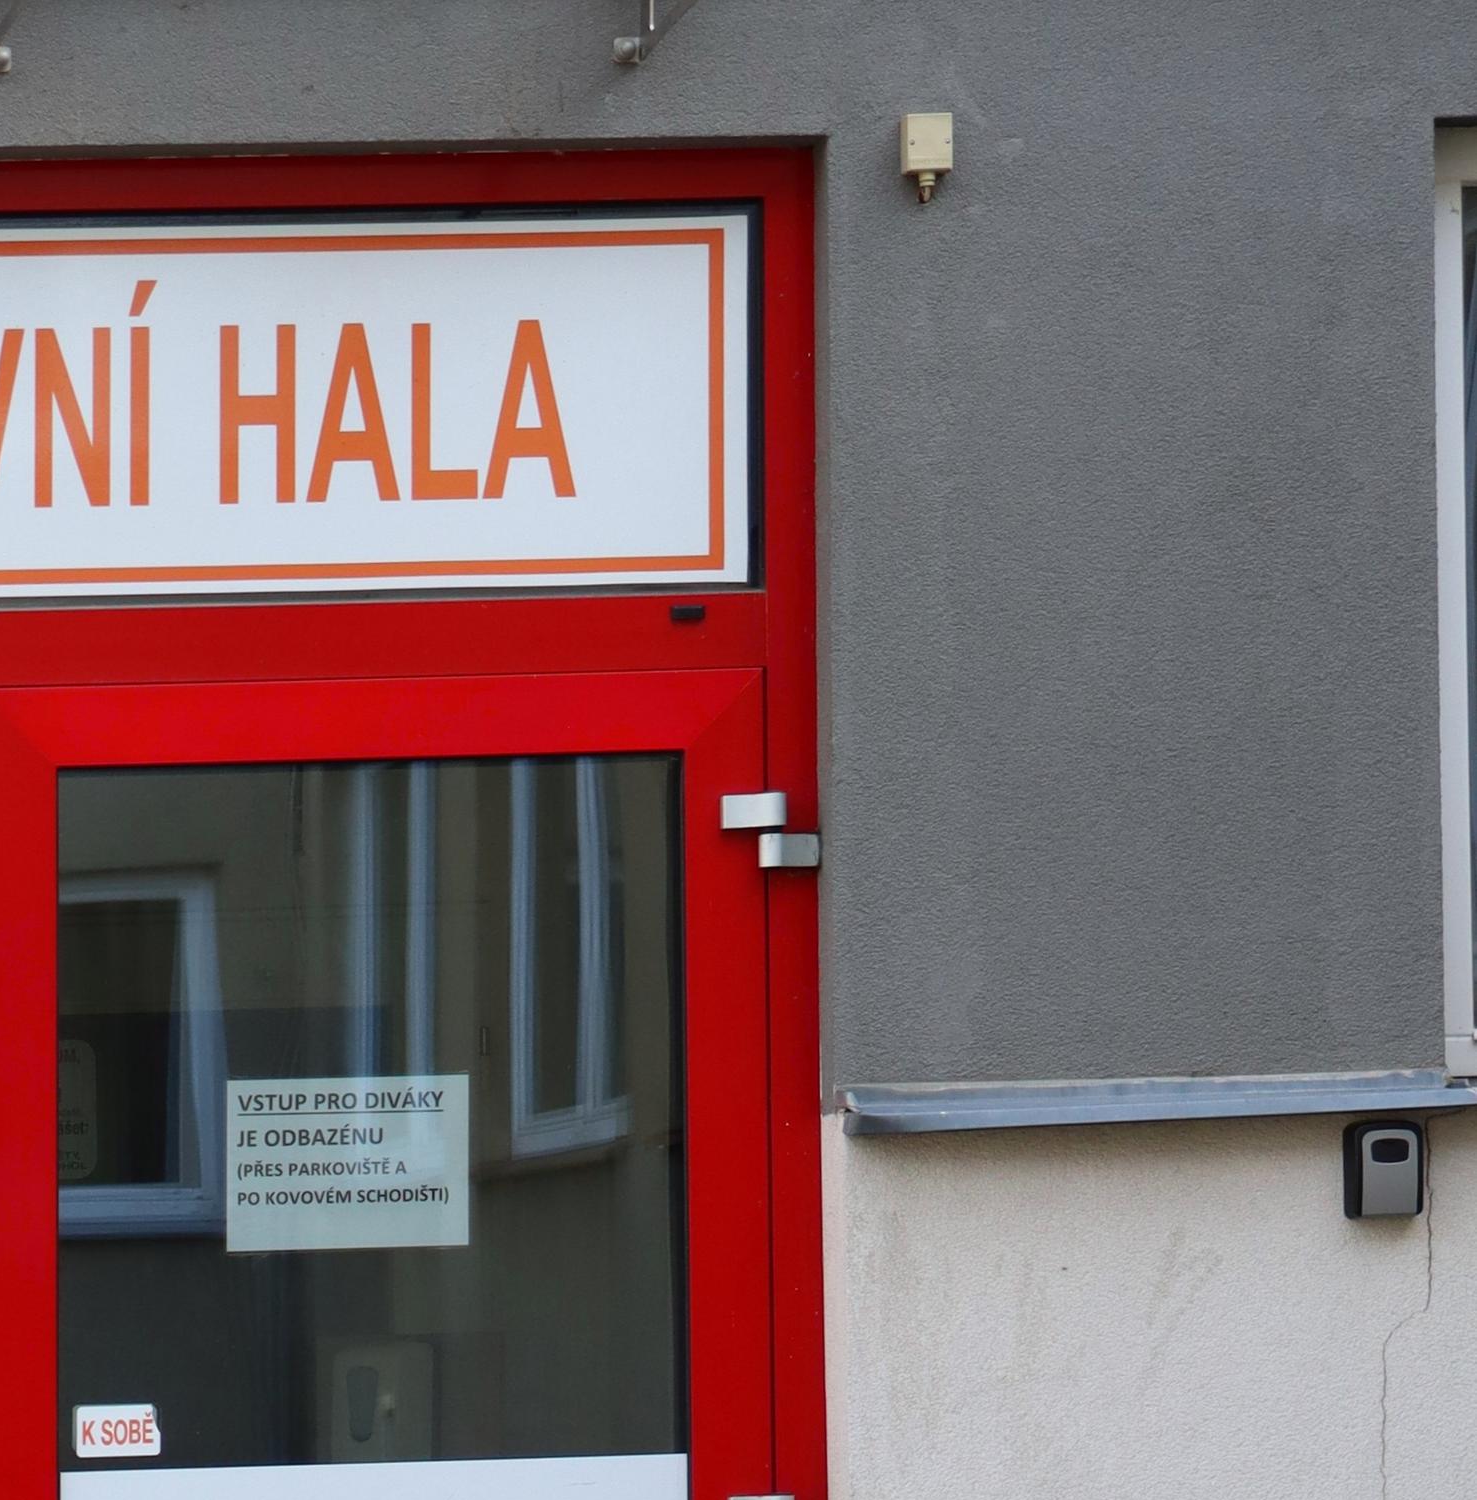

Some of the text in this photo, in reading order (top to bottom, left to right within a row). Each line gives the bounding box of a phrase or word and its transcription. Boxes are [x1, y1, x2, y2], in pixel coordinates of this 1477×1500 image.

[218, 318, 577, 505] HALA
[237, 1087, 444, 1112] VSTUP PRO DIVÁKY
[237, 1130, 257, 1147] JE
[237, 1157, 407, 1181] (PŘES PARKOVIŠTĚ A
[237, 1184, 449, 1206] PO KOVOVÉM SCHODIŠTI)
[82, 1411, 154, 1446] K SOBĚ
